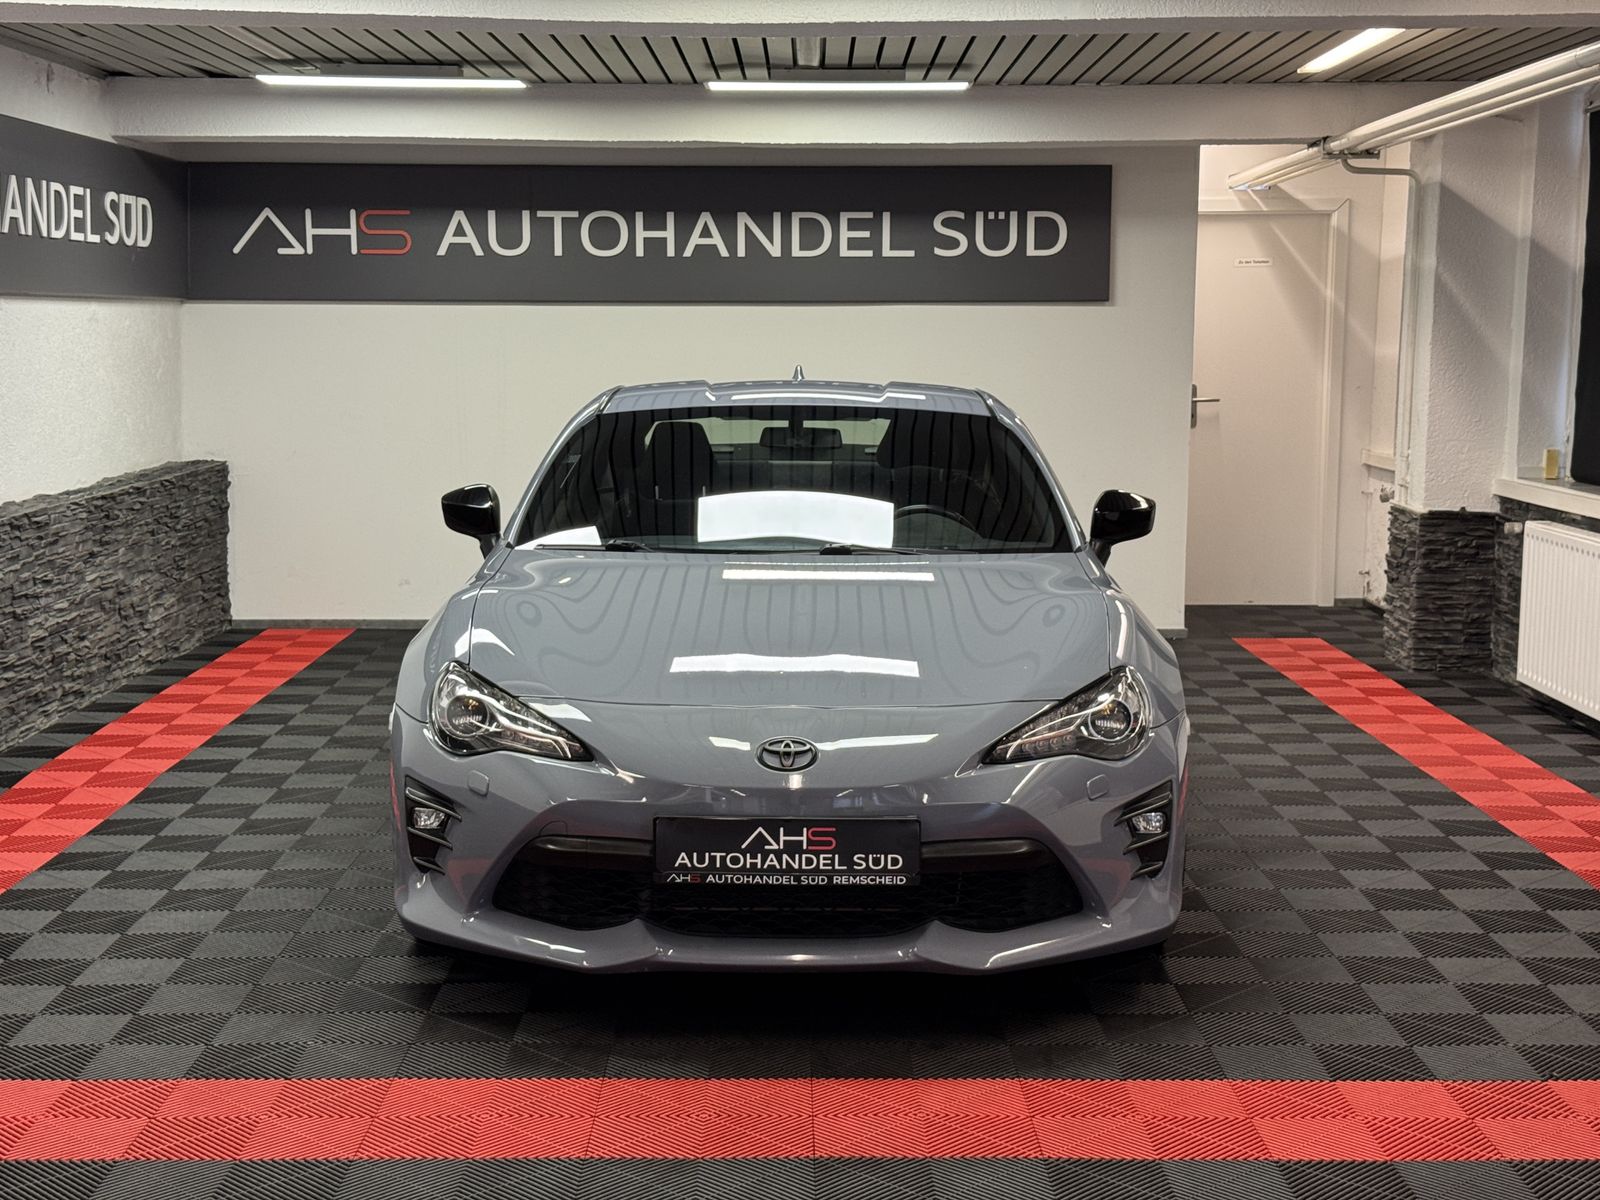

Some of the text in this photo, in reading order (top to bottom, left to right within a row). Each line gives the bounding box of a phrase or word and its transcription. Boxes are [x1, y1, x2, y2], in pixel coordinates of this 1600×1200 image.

[0, 174, 153, 248] ANDEL SÜD
[232, 207, 1068, 258] AHS AUTOHANDEL SÜD
[740, 826, 837, 851] AHS
[674, 852, 903, 870] AUTOHANDEL SÜD
[705, 874, 798, 885] AUTOHANDEL
[800, 874, 828, 885] SÜD
[832, 875, 907, 885] REMSCHEID
